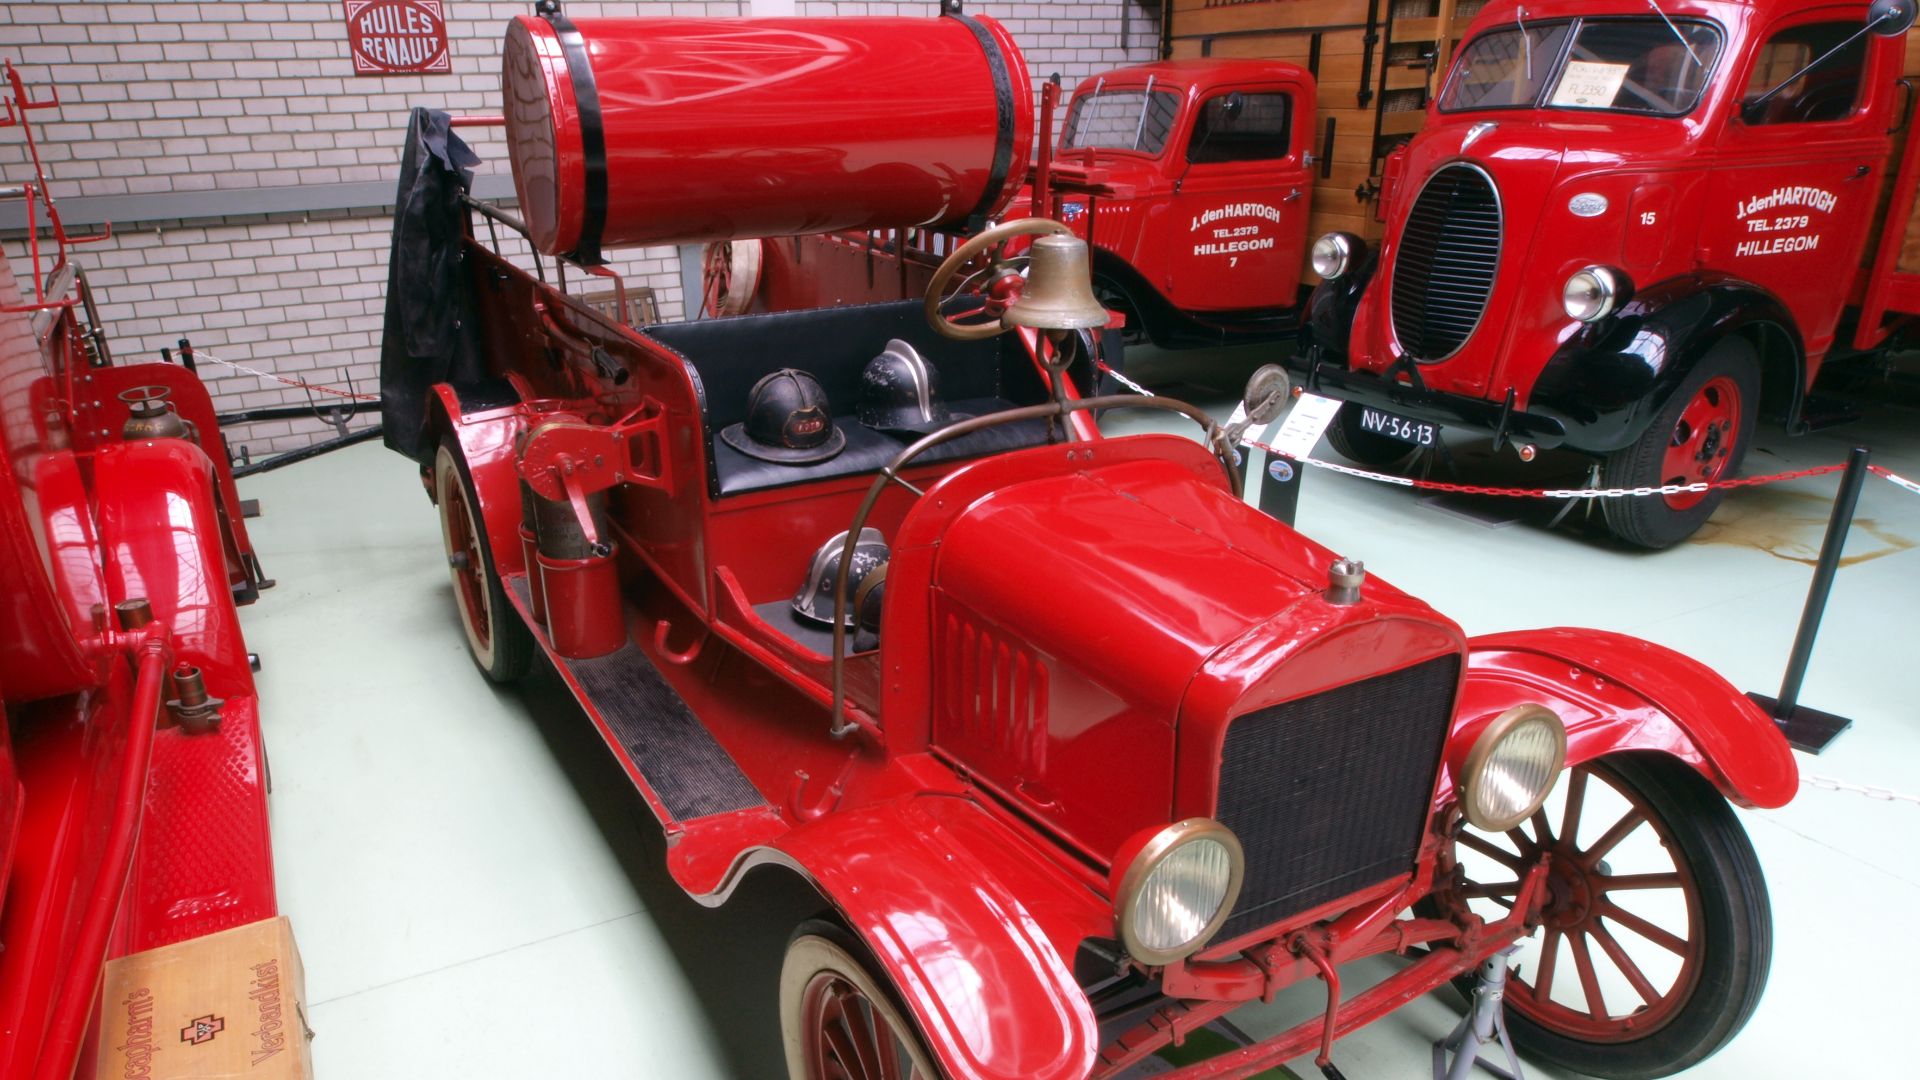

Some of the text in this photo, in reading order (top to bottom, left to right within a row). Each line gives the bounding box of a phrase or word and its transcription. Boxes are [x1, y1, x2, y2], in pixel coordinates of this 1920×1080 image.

[360, 5, 434, 34] HUILES
[361, 37, 439, 66] RENAULT
[1640, 211, 1657, 225] 15
[1194, 238, 1274, 256] HILLEGOM
[1735, 234, 1820, 257] HILLEGOM
[1230, 257, 1238, 268] 7
